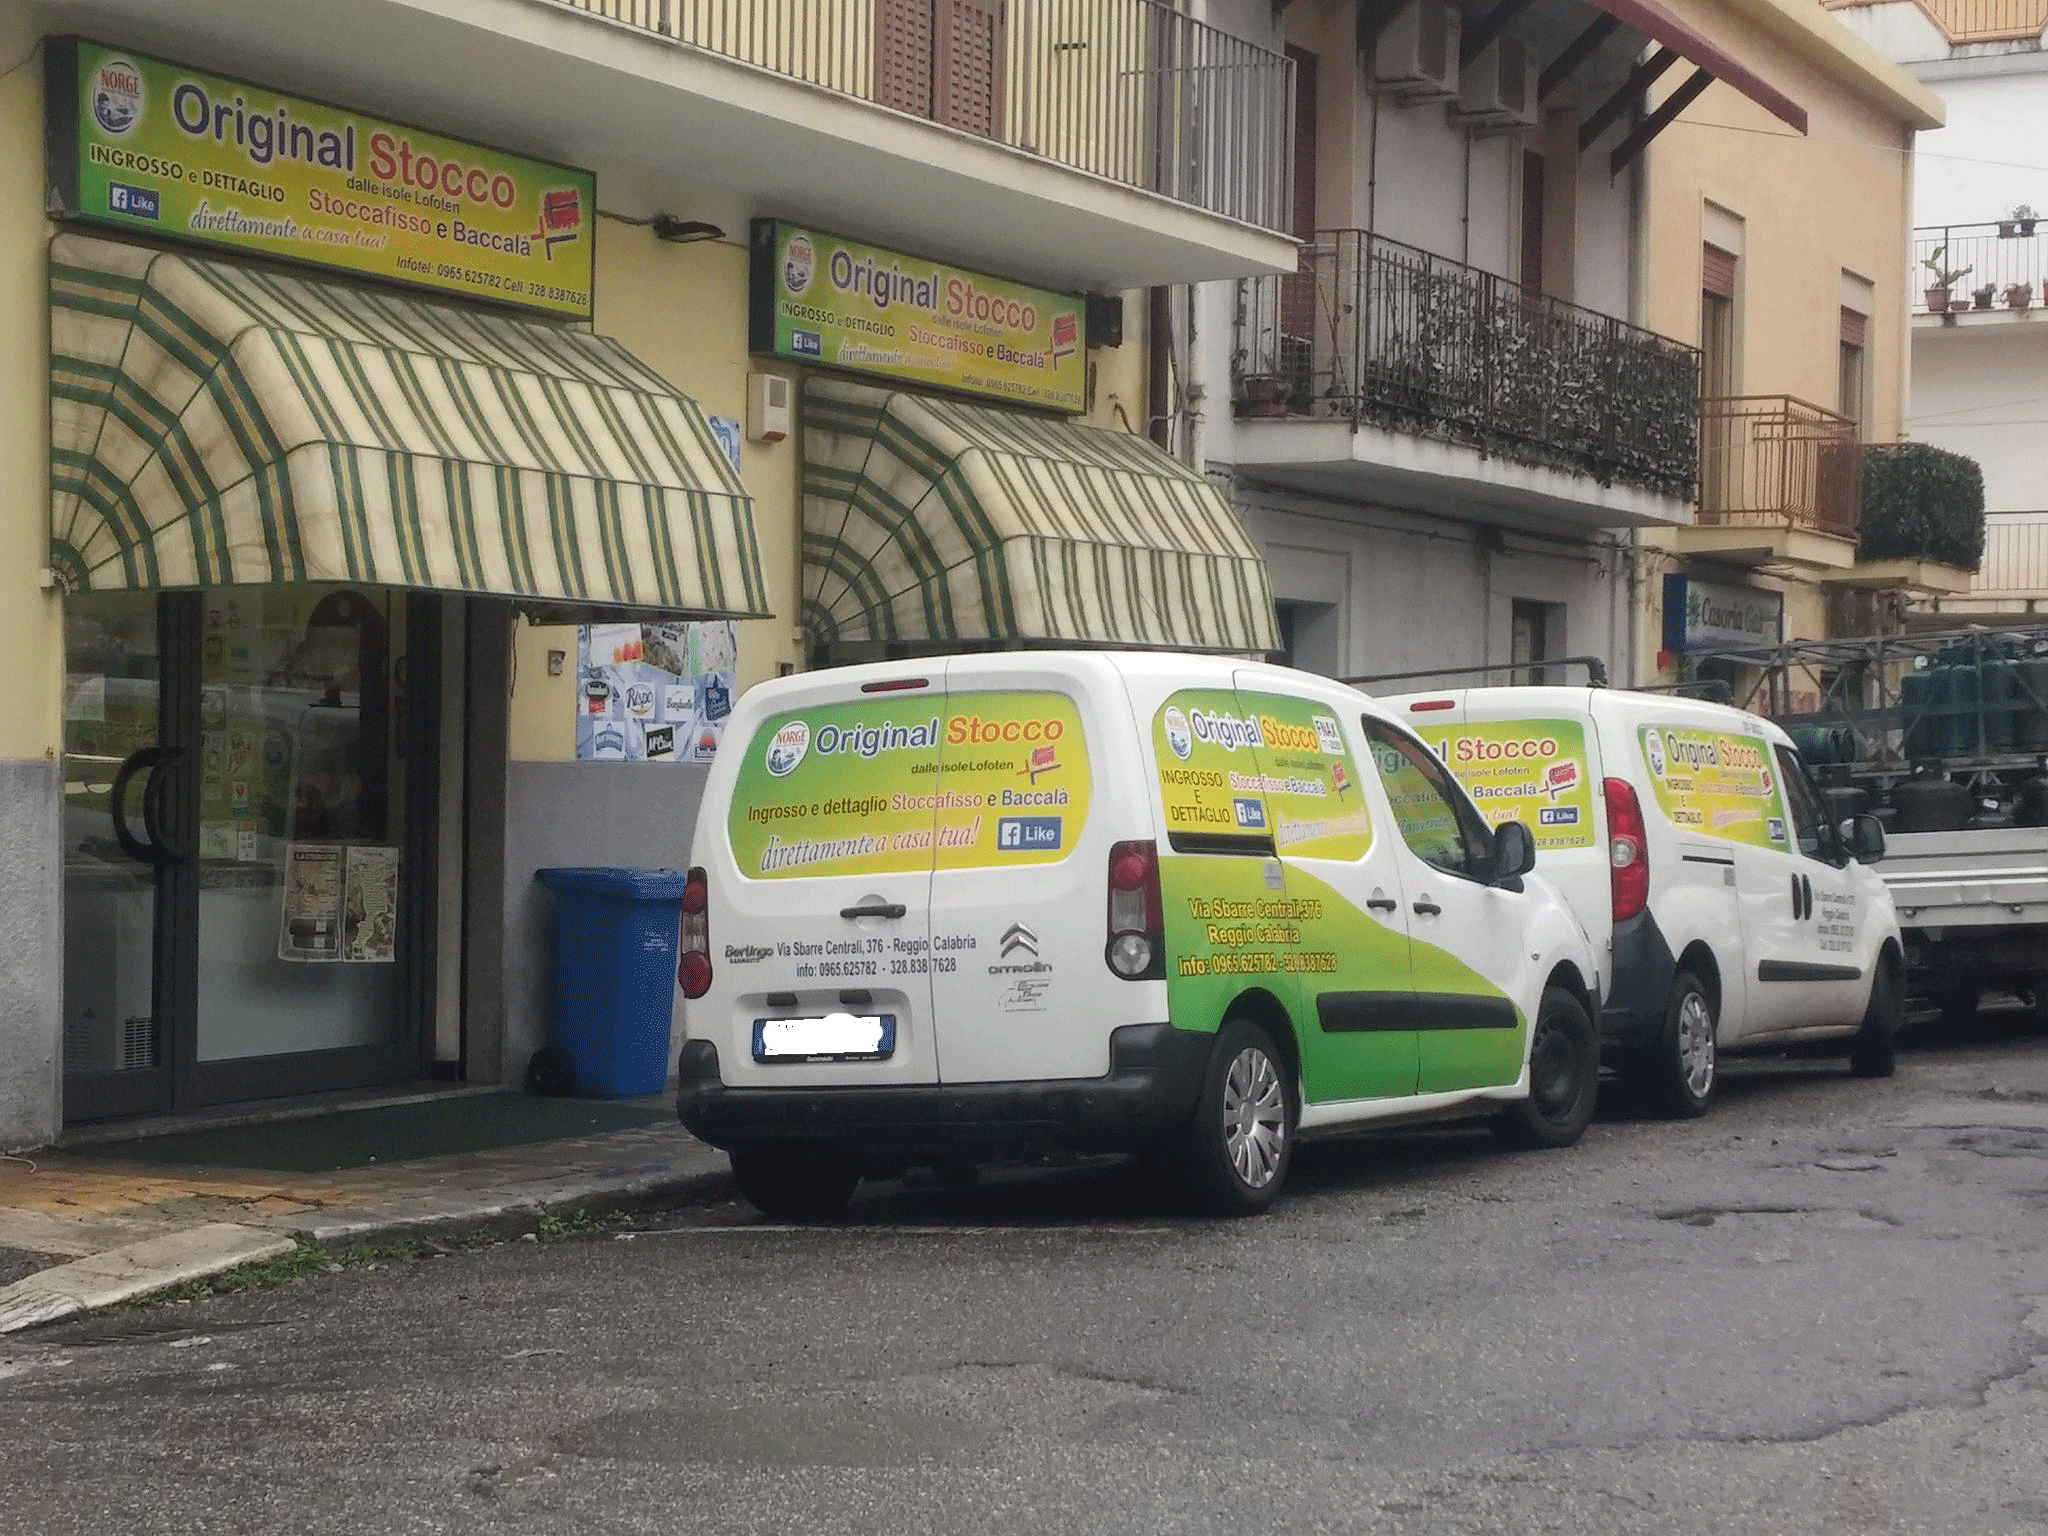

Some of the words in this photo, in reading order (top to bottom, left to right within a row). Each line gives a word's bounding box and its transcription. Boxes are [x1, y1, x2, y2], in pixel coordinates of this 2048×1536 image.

[101, 68, 139, 95] NORGE
[173, 83, 354, 171] Original
[370, 133, 515, 208] Stocco
[90, 144, 183, 180] INGROSSO
[188, 171, 198, 183] e
[203, 170, 285, 203] DETTAGLIO
[131, 194, 155, 212] Like
[347, 175, 379, 195] dalle
[382, 185, 412, 202] isole
[415, 191, 460, 214] Lofoten
[191, 200, 297, 239] direttamente
[302, 227, 313, 240] a
[316, 229, 350, 244] casa
[355, 230, 387, 249] tua!
[309, 188, 432, 235] Stoccafisso
[436, 222, 448, 238] e
[453, 220, 531, 257] Baccalà
[396, 255, 434, 275] Infotel:
[831, 250, 938, 310] Original
[947, 279, 1035, 331] Stocco
[782, 302, 835, 325] INGROSSO
[845, 316, 895, 337] DETTAGLIO
[910, 325, 984, 356] Stoccafisso
[986, 345, 994, 359] e
[997, 343, 1044, 368] Baccalà
[776, 729, 808, 745] NORGE
[816, 717, 939, 756] Original
[947, 717, 1064, 745] Stocco
[1192, 711, 1263, 749] Original
[1262, 719, 1318, 750] Stocco
[1456, 738, 1557, 761] Stocco
[1667, 733, 1719, 771] Original
[911, 763, 939, 774] dalle
[1162, 770, 1223, 787] INGROSSO
[1194, 789, 1202, 804] E
[1473, 783, 1537, 798] Baccalà
[748, 804, 808, 824] Ingrosso
[811, 803, 819, 816] e
[823, 796, 887, 817] dettaglio
[891, 791, 983, 811] Stoccafisso
[987, 793, 997, 807] e
[1001, 787, 1069, 806] Baccalà
[1171, 806, 1231, 823] DETTAGLIO
[761, 835, 874, 872] direttamente
[875, 837, 887, 851] a
[893, 831, 930, 850] casa
[938, 815, 981, 848] tua!
[1025, 826, 1055, 841] Like
[1188, 898, 1212, 919] Via
[1212, 898, 1255, 919] Sbarre
[725, 944, 774, 960] Berlingo
[777, 941, 791, 956] Via
[793, 940, 823, 956] Sbarre
[825, 939, 865, 957] Centrali,
[867, 938, 884, 954] 376
[893, 936, 929, 955] Reggio
[934, 934, 977, 950] Calabria
[1207, 924, 1255, 949] Reggio
[1256, 923, 1301, 944] Calabria
[797, 963, 817, 977] info:
[819, 960, 878, 977] 0965.625782
[1178, 955, 1210, 977] Info:
